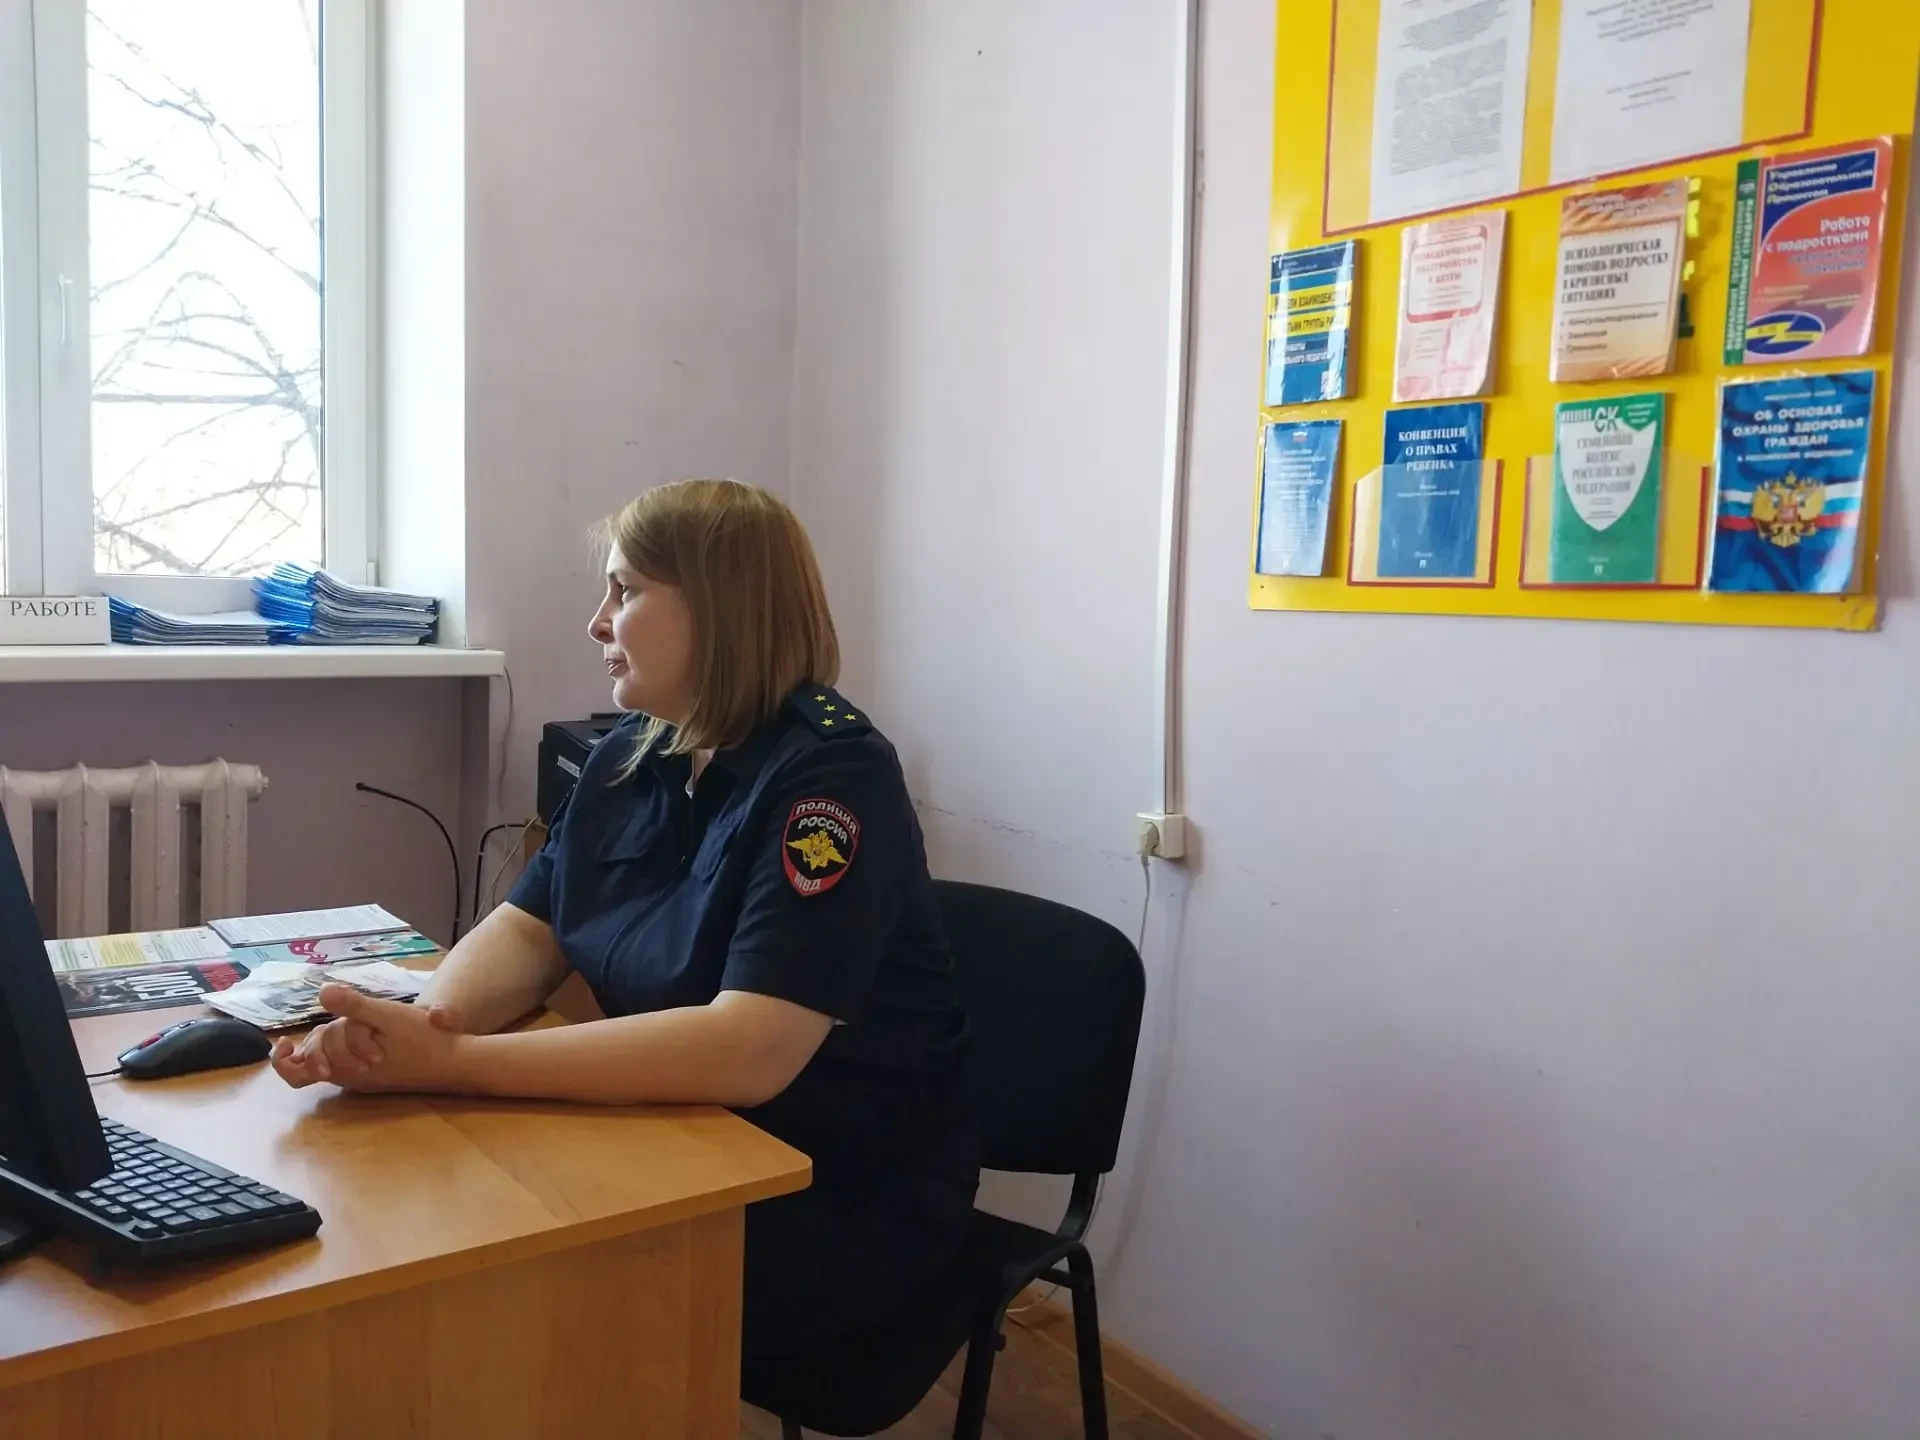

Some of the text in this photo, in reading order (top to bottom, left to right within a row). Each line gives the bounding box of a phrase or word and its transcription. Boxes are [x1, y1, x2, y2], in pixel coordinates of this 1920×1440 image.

[1820, 216, 1870, 233] Работа
[1564, 238, 1661, 261] ПСИХОЛОГИЧЕСКАЯ
[1563, 252, 1669, 275] ПОМОЩЬ ПОДРОСТКУ
[1569, 272, 1629, 289] КРИЗИСНЫХ
[1561, 288, 1616, 304] СИТУАЦИЯХ
[1594, 406, 1620, 432] СК
[1754, 404, 1843, 421] ОБ ОСНОВАХ
[1398, 427, 1467, 442] КОНВЕНЦИЯ
[1732, 417, 1864, 437] ОХРАНЫ ЗДОРОВЬЯ
[1405, 443, 1458, 456] О ПРАВАХ
[1764, 434, 1829, 448] ГРАЖДАН
[1406, 459, 1455, 472] РЕБЕНКА
[10, 601, 98, 617] РАБОТЕ
[796, 801, 857, 834] ПОЛИЦИЯ
[798, 816, 848, 845] РОССИЯ
[794, 871, 822, 892] МВД
